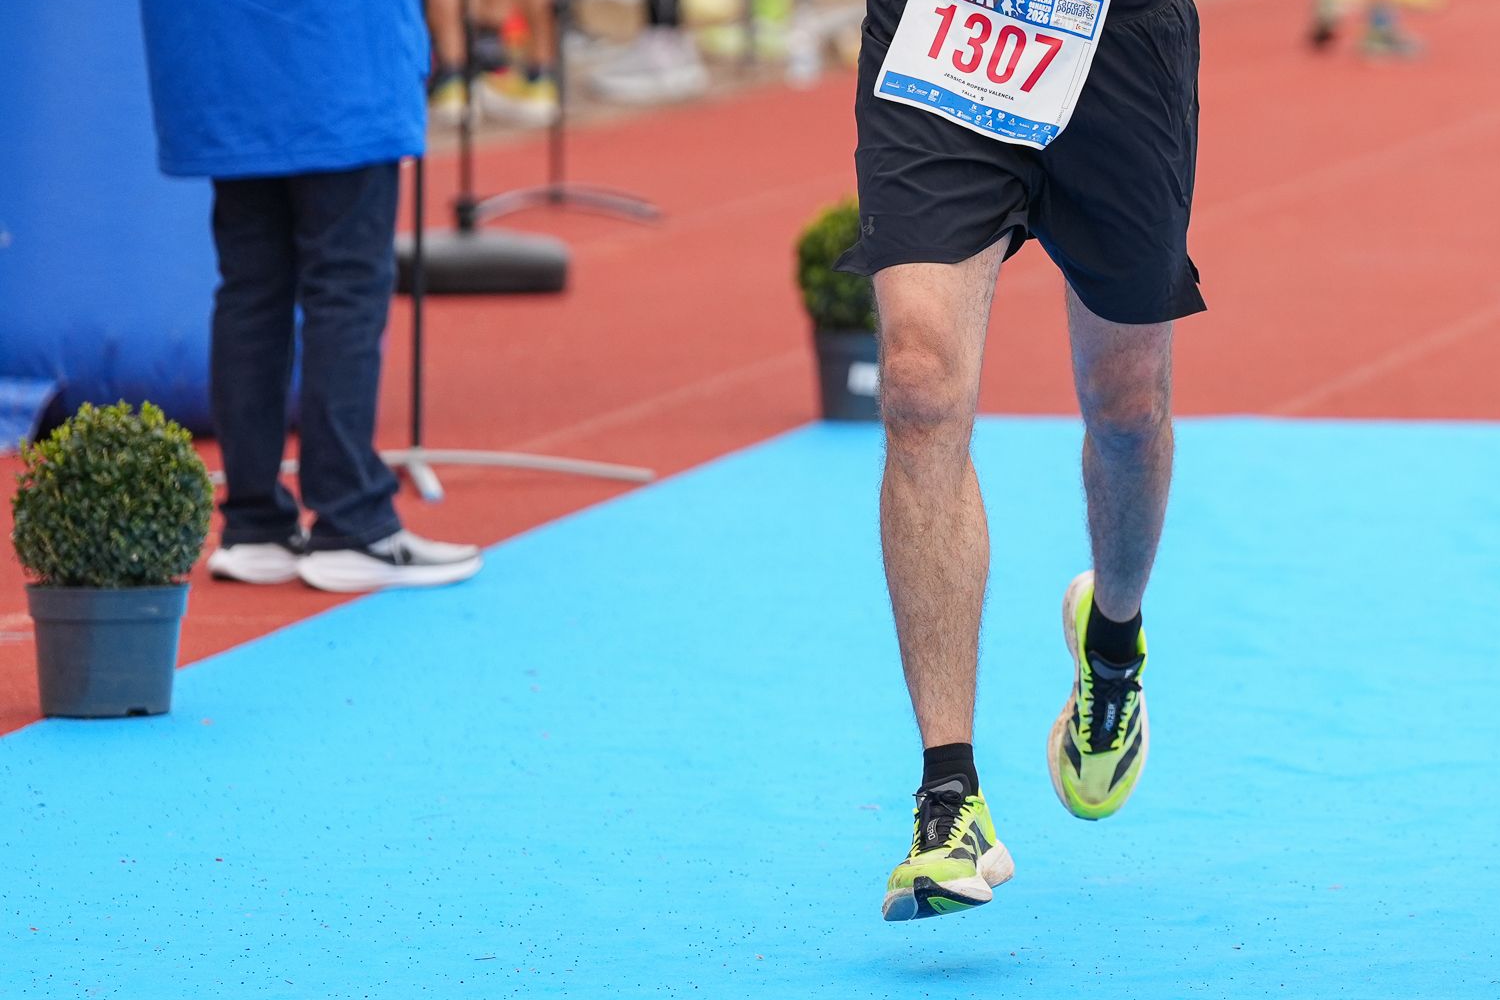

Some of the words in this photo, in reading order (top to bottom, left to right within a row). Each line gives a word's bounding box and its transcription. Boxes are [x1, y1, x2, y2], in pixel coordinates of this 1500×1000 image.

[1025, 8, 1049, 24] 2026
[1056, 5, 1094, 21] populares
[927, 4, 1064, 93] 1307
[944, 72, 966, 85] JESSICA
[966, 81, 988, 93] ROPERO
[989, 89, 1015, 101] VALENCIA
[961, 90, 976, 99] TALLA
